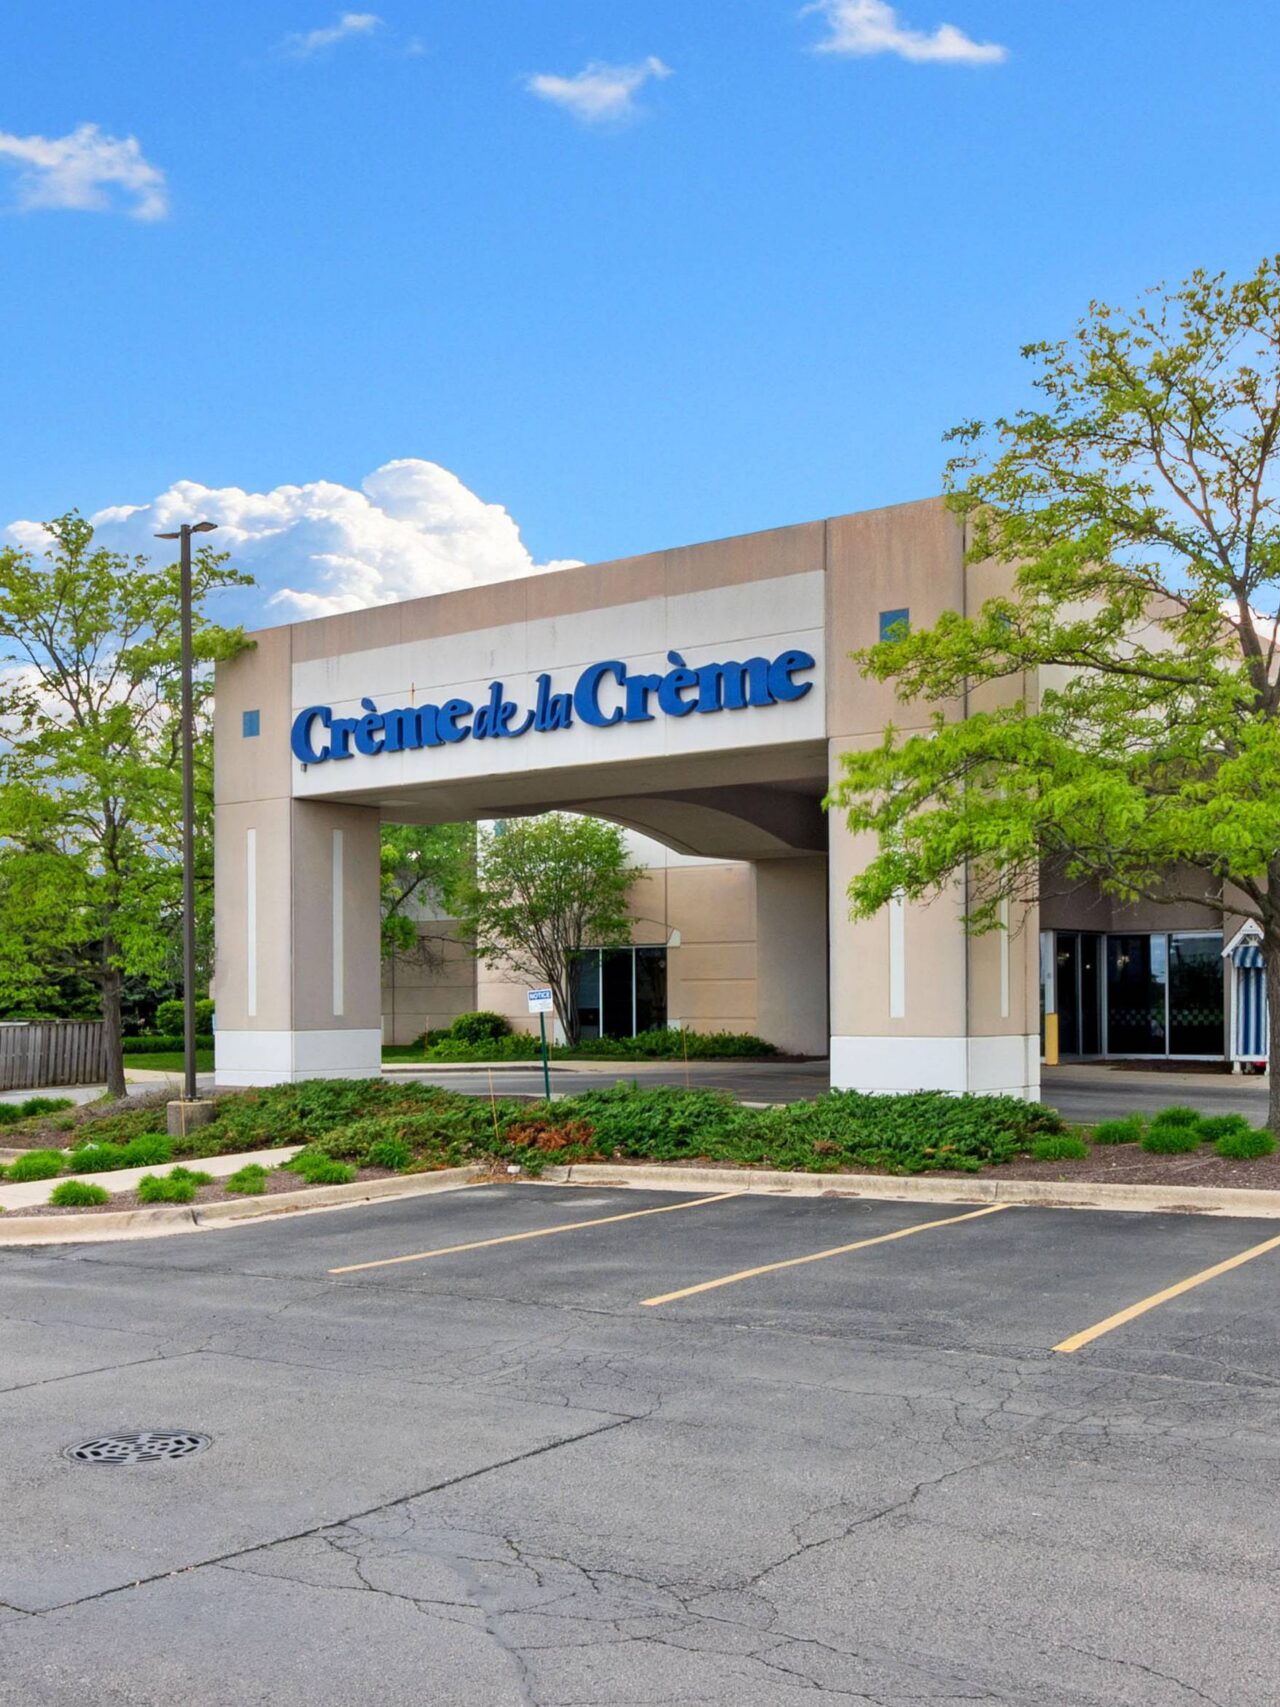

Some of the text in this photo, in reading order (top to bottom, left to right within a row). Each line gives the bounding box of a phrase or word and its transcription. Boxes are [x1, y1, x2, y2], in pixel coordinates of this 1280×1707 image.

[291, 650, 815, 764] Crème de la Crème
[529, 991, 551, 1000] NOTICE
